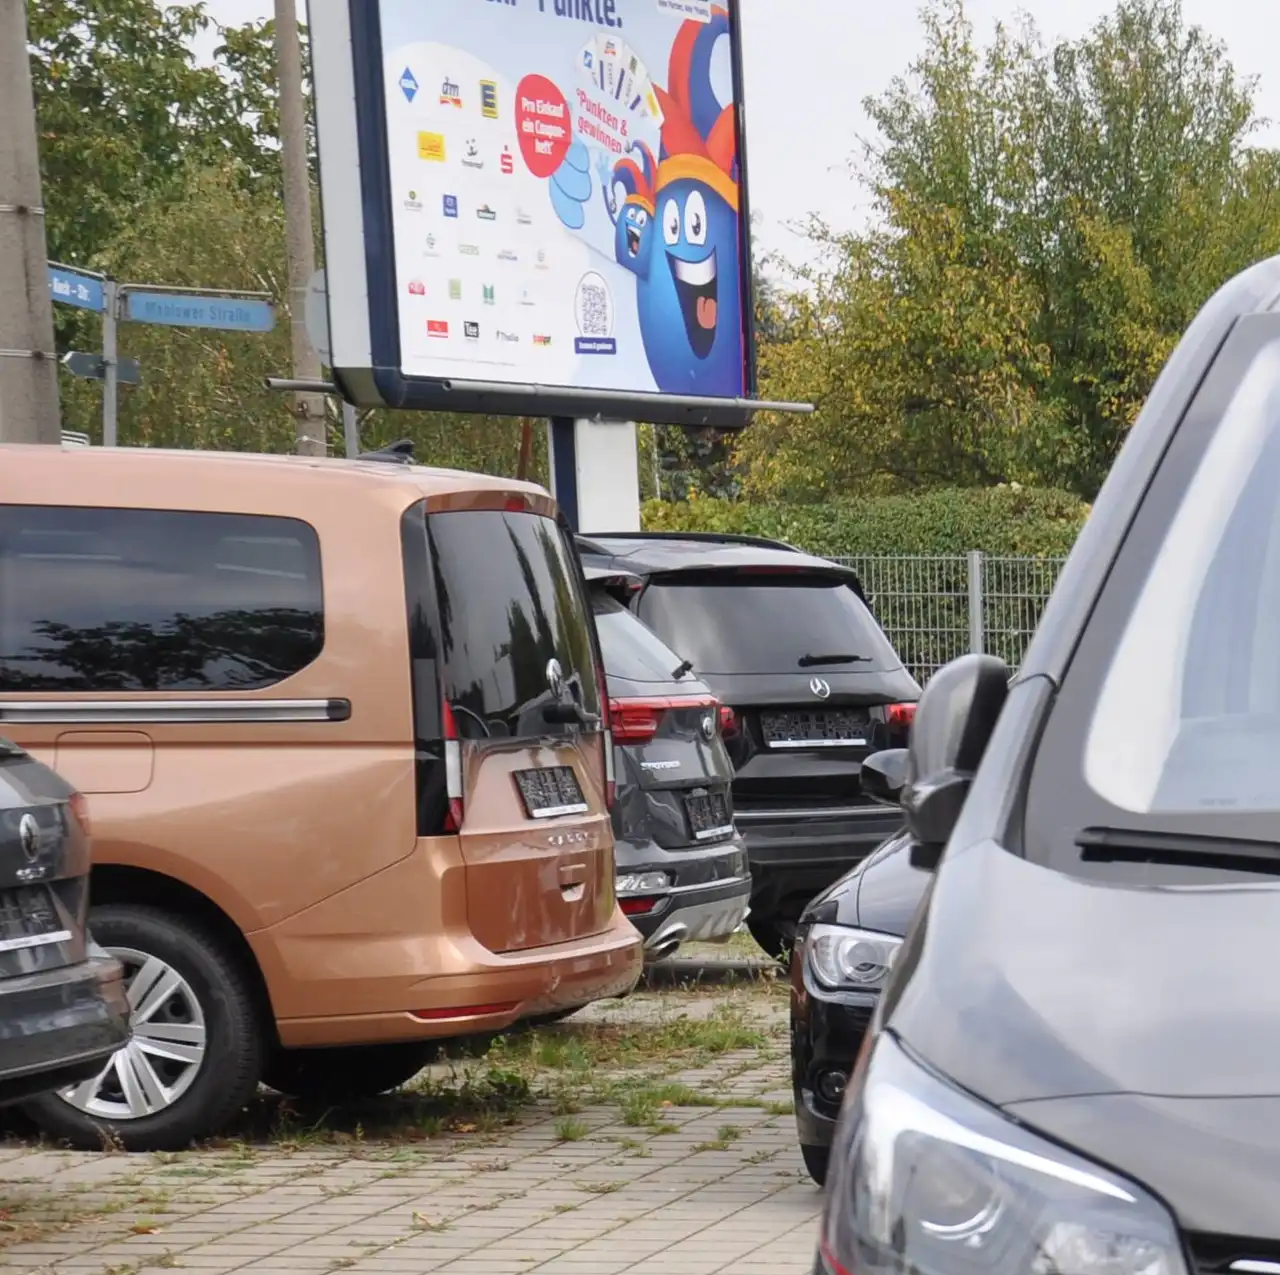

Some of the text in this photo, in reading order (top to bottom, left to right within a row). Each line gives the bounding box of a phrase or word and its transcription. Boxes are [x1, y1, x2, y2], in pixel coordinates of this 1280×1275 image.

[522, 97, 535, 113] Pro
[578, 116, 622, 154] gewinnen
[620, 119, 628, 137] &
[209, 305, 251, 322] Straße
